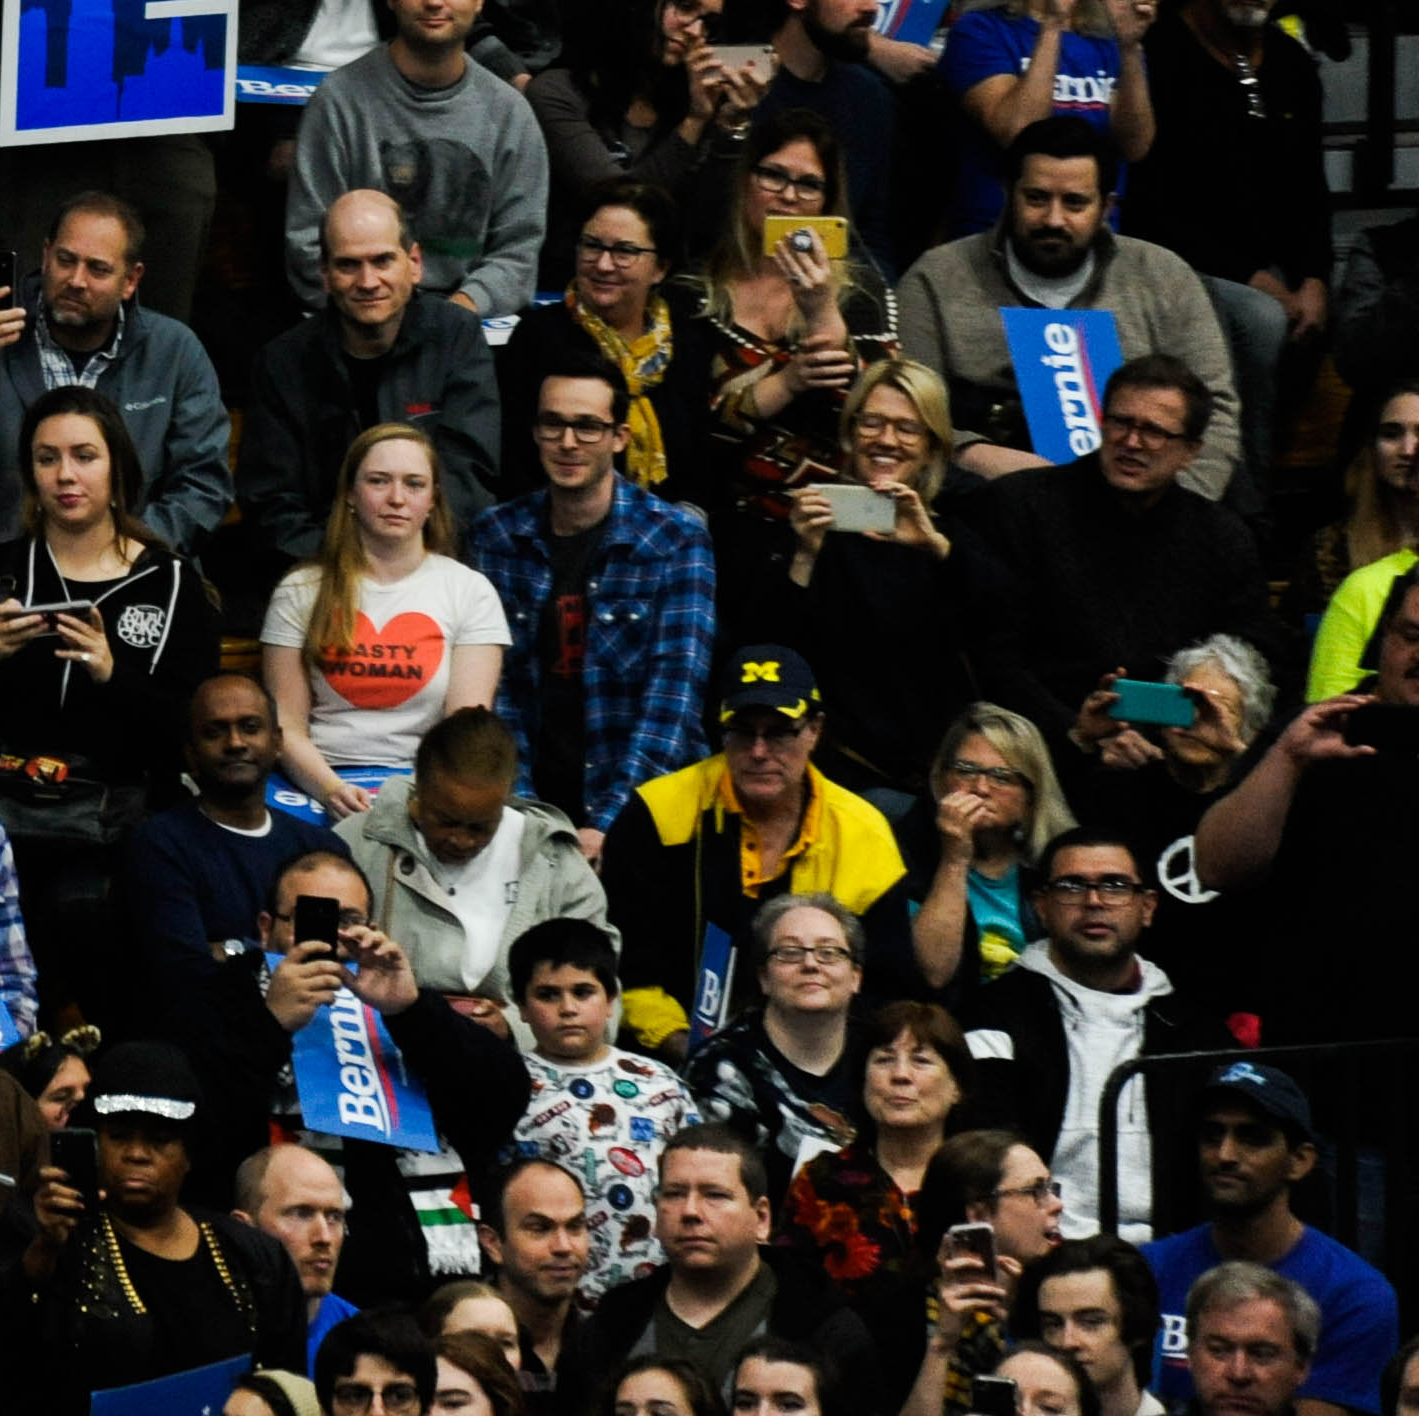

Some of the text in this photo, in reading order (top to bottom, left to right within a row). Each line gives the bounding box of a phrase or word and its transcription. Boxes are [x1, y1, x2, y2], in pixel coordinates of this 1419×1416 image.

[241, 78, 316, 93] Ber
[1039, 320, 1101, 454] ernie
[326, 659, 422, 680] WOMAN
[741, 660, 780, 683] M
[333, 977, 377, 1130] Berni
